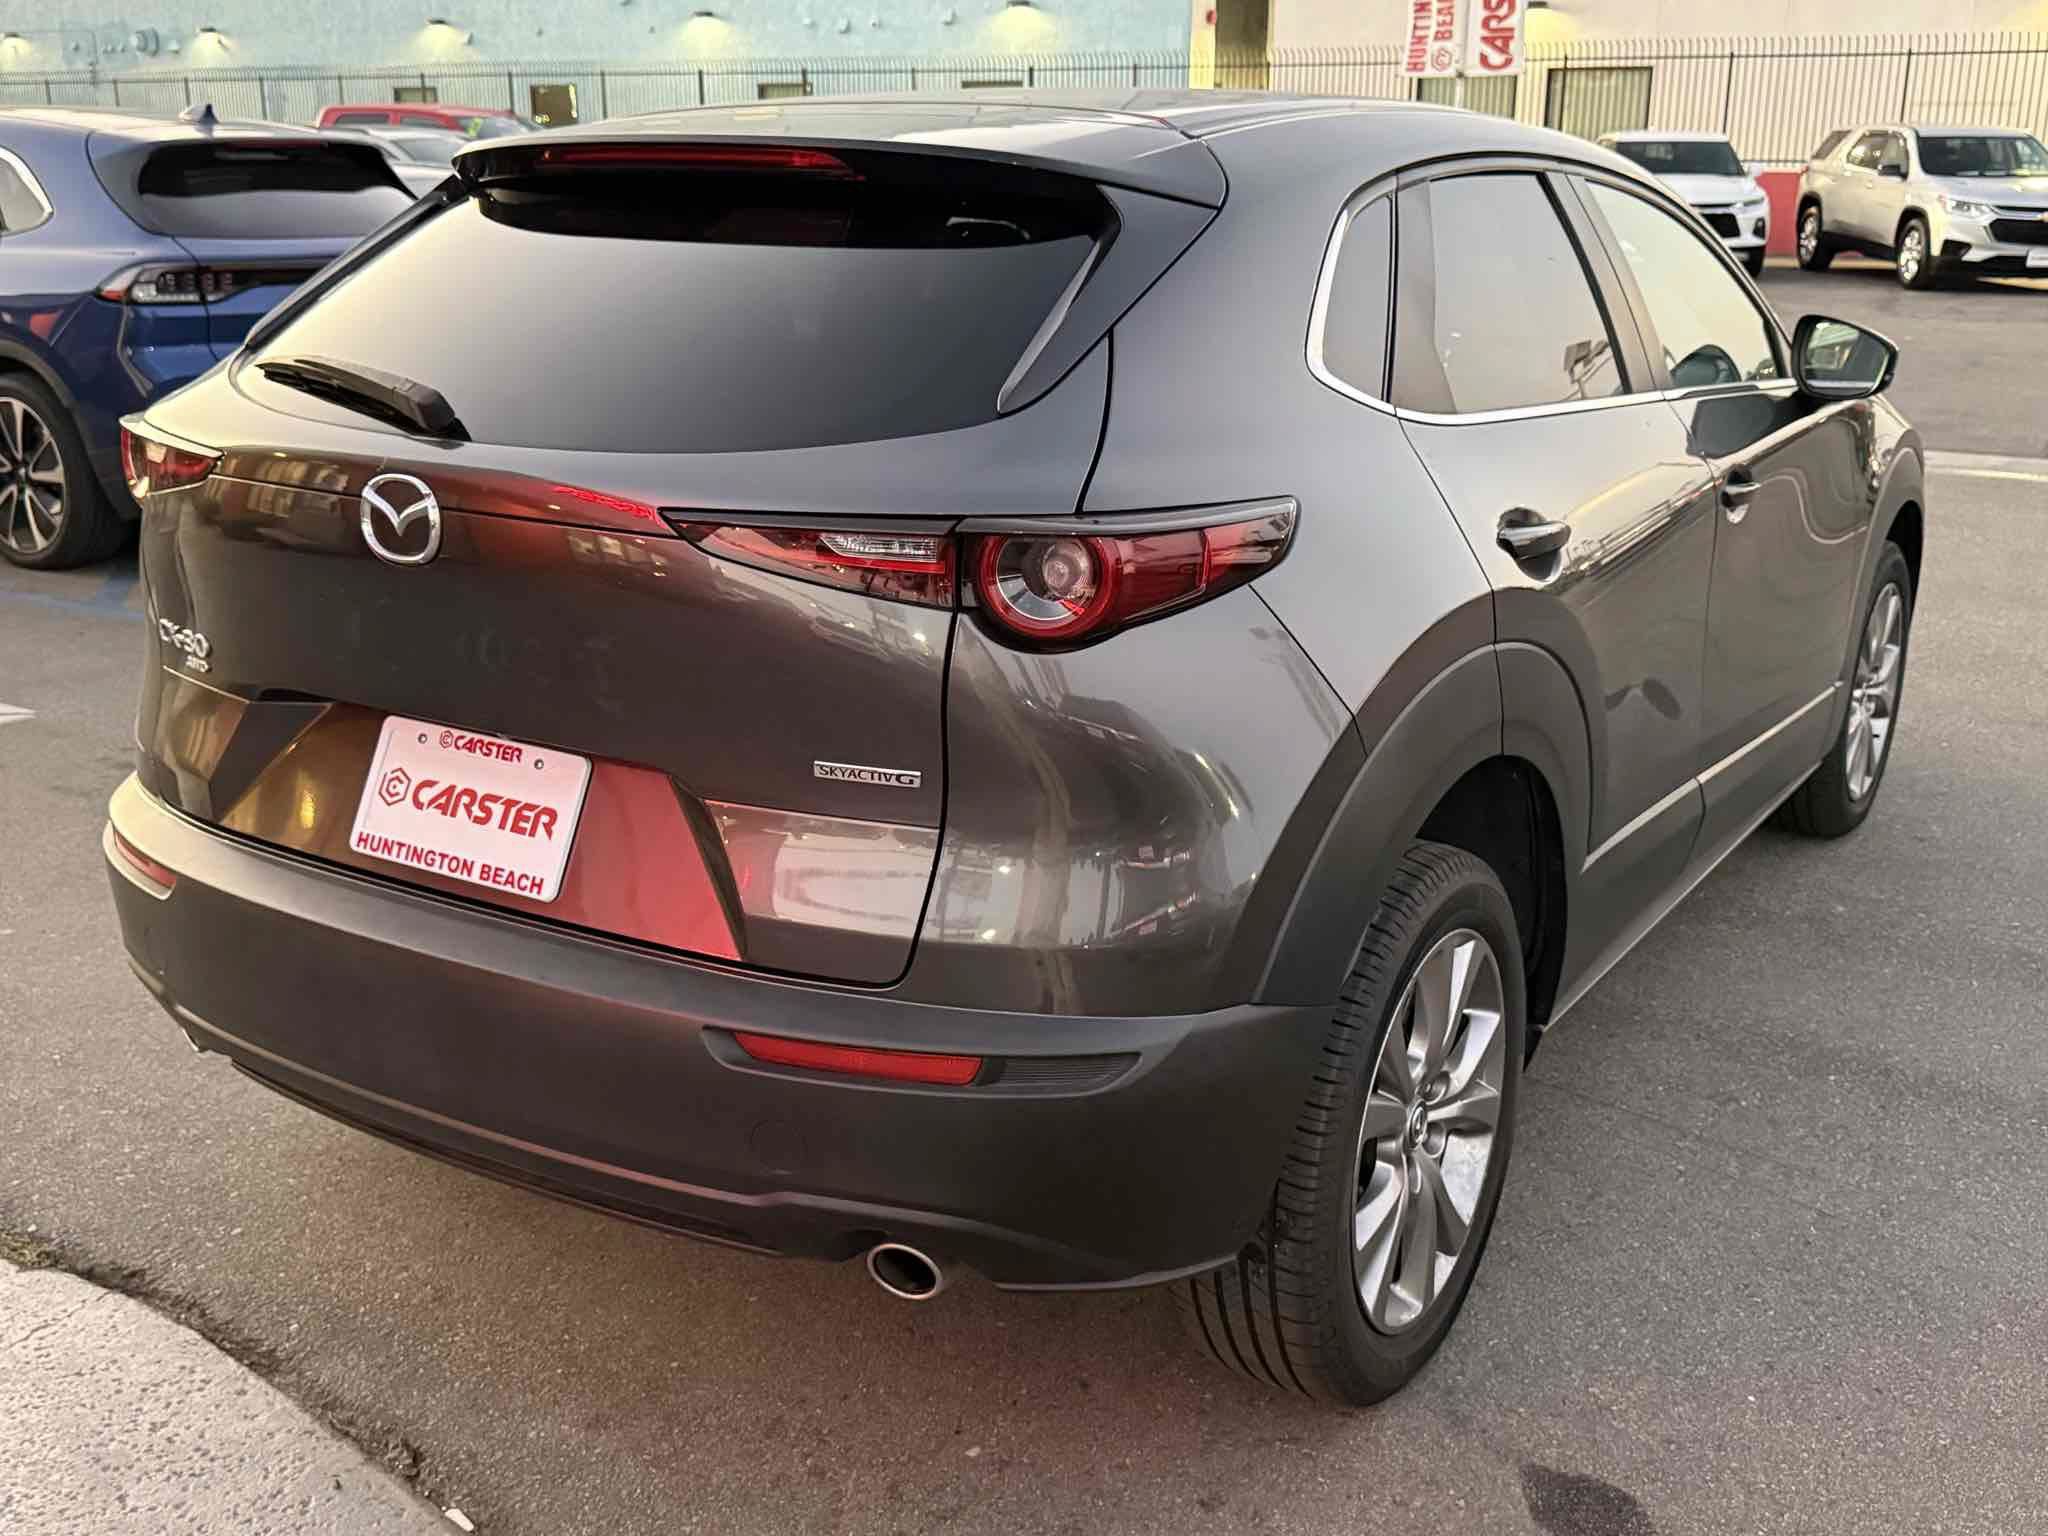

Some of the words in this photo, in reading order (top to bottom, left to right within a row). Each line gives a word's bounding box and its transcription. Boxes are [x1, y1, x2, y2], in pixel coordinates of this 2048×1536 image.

[1433, 0, 1454, 41] BEA
[454, 735, 523, 763] CARSTER
[412, 779, 558, 841] CARSTER
[356, 831, 475, 878] HUNTINGTON
[479, 863, 545, 896] BEACH
